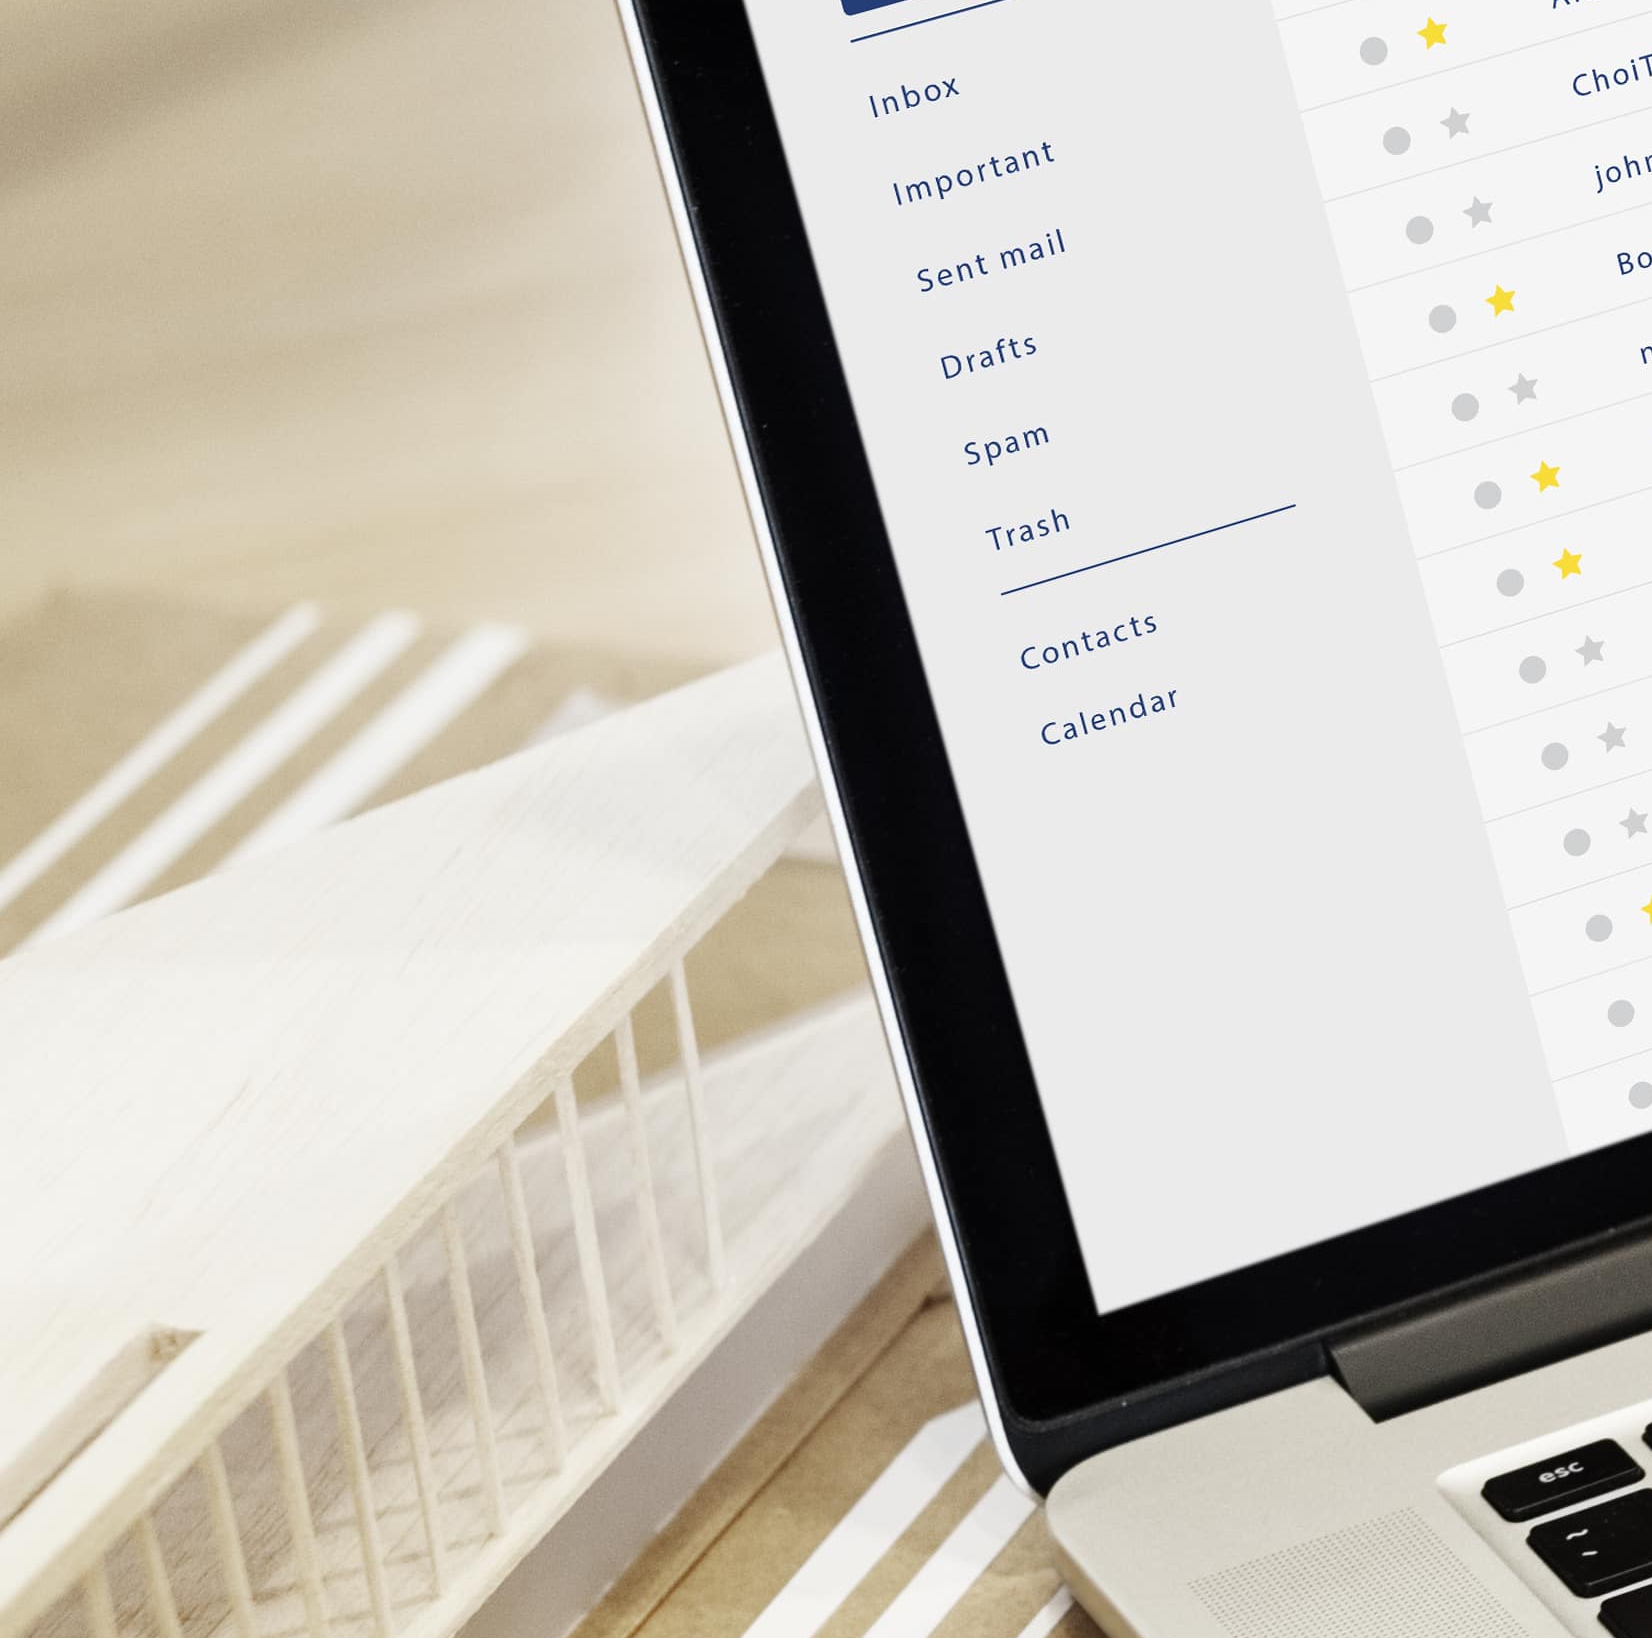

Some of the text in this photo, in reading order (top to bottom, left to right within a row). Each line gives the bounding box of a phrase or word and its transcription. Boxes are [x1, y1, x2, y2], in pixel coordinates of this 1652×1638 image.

[868, 77, 961, 119] Inbox
[892, 141, 1056, 207] Important
[916, 228, 1066, 293] Sent mail
[940, 337, 1037, 380] Drafts
[963, 426, 1050, 467] Spam
[984, 508, 1070, 551] Trash
[1020, 615, 1158, 670] Contacts
[1040, 689, 1177, 746] Calendar
[1535, 1459, 1585, 1484] esc
